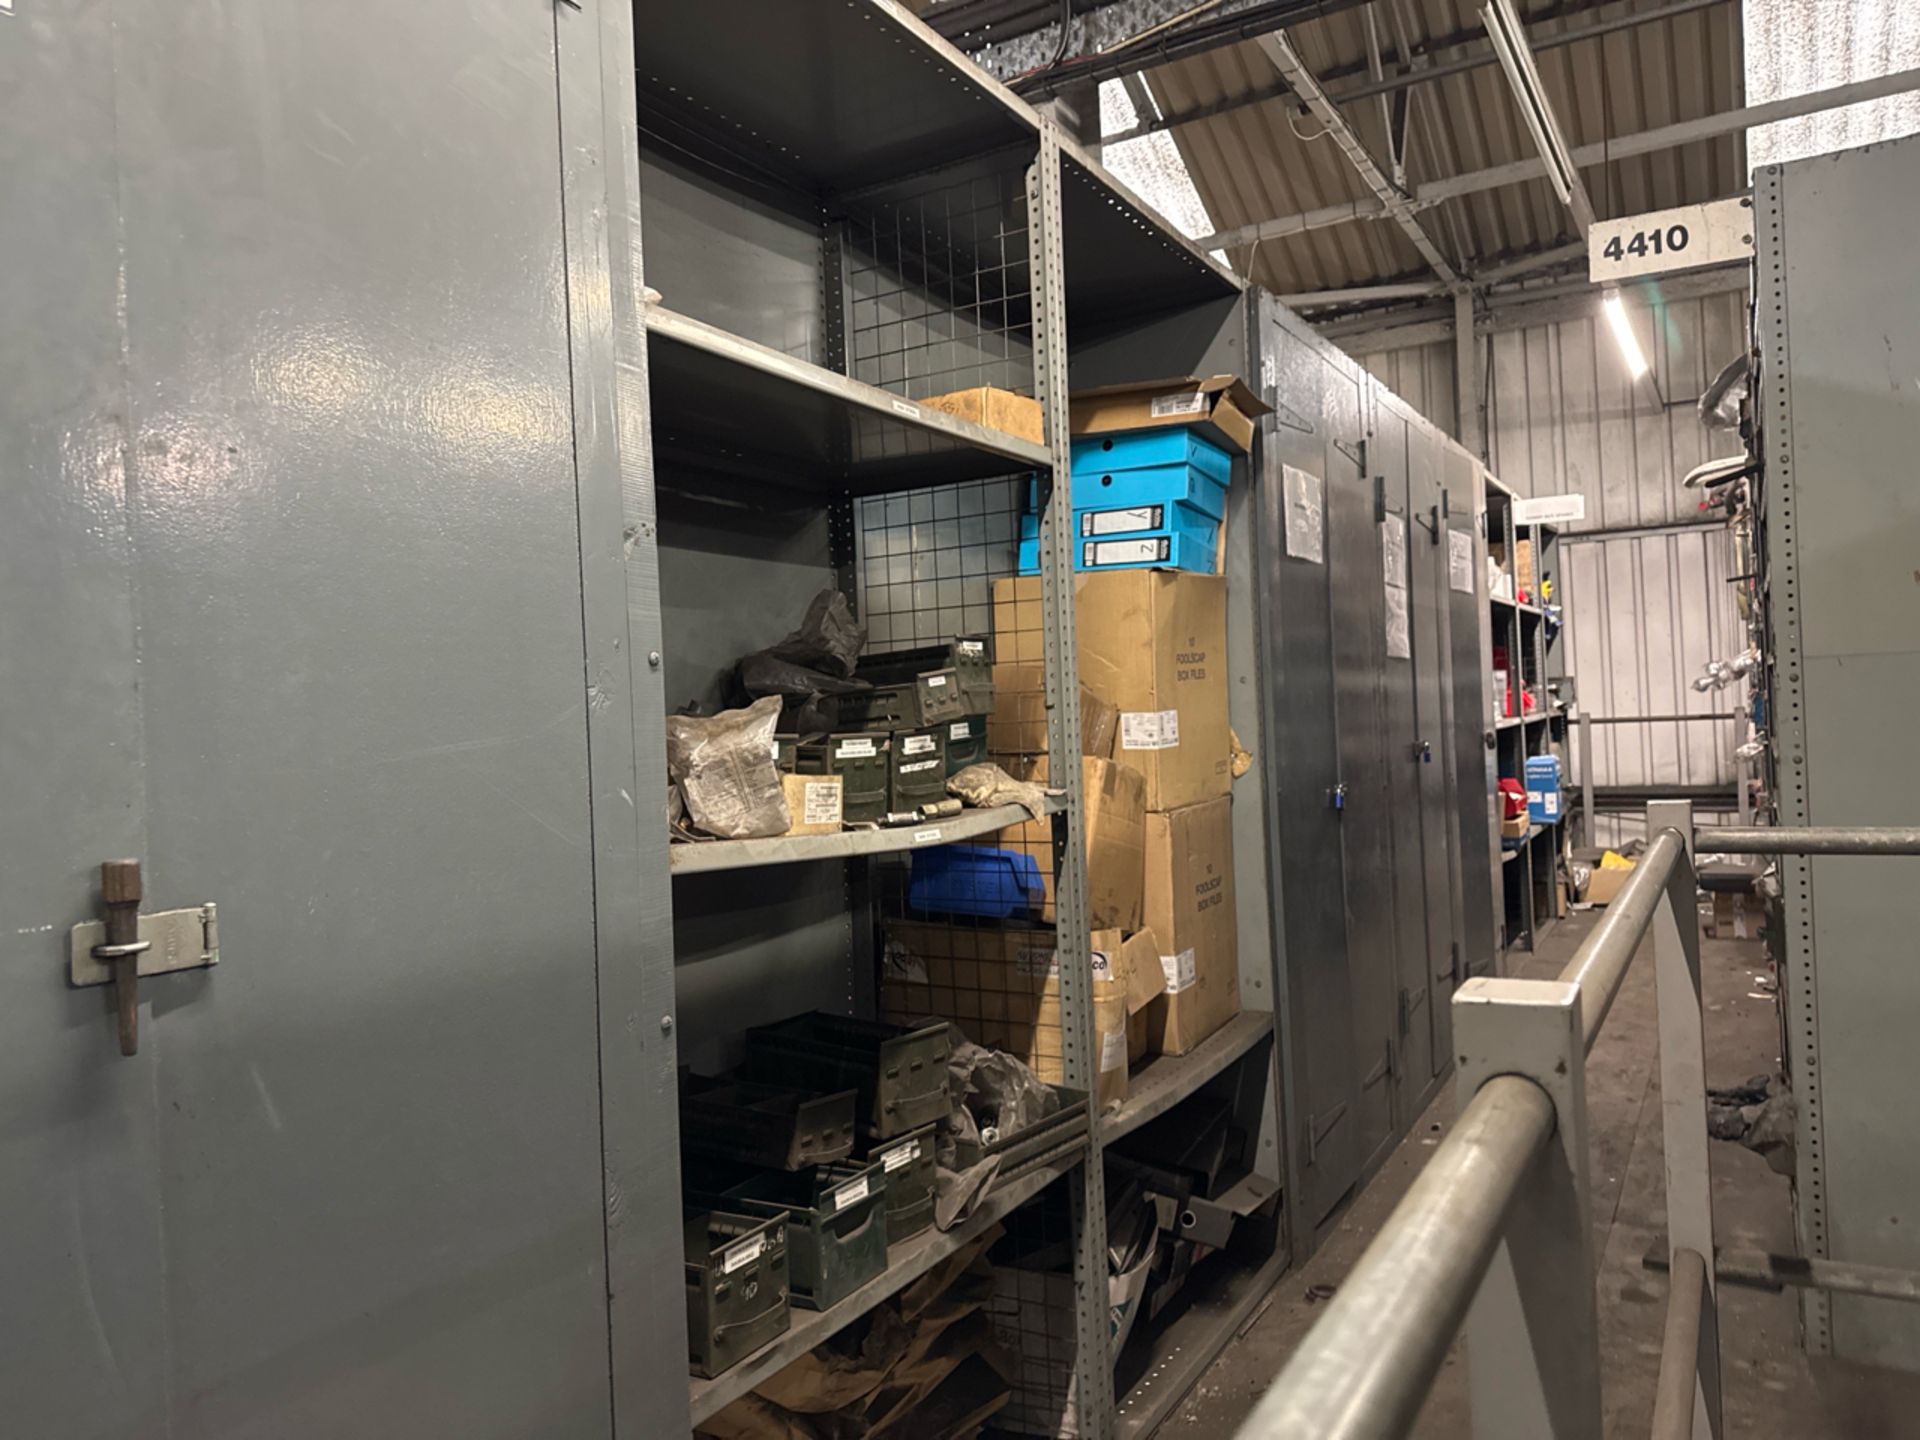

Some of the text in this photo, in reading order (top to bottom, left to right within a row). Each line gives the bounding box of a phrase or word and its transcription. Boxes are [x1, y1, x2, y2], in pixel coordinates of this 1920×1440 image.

[1603, 224, 1689, 262] 4410
[1175, 651, 1206, 665] FOOLSCAP
[1176, 668, 1206, 681] BOX FILES
